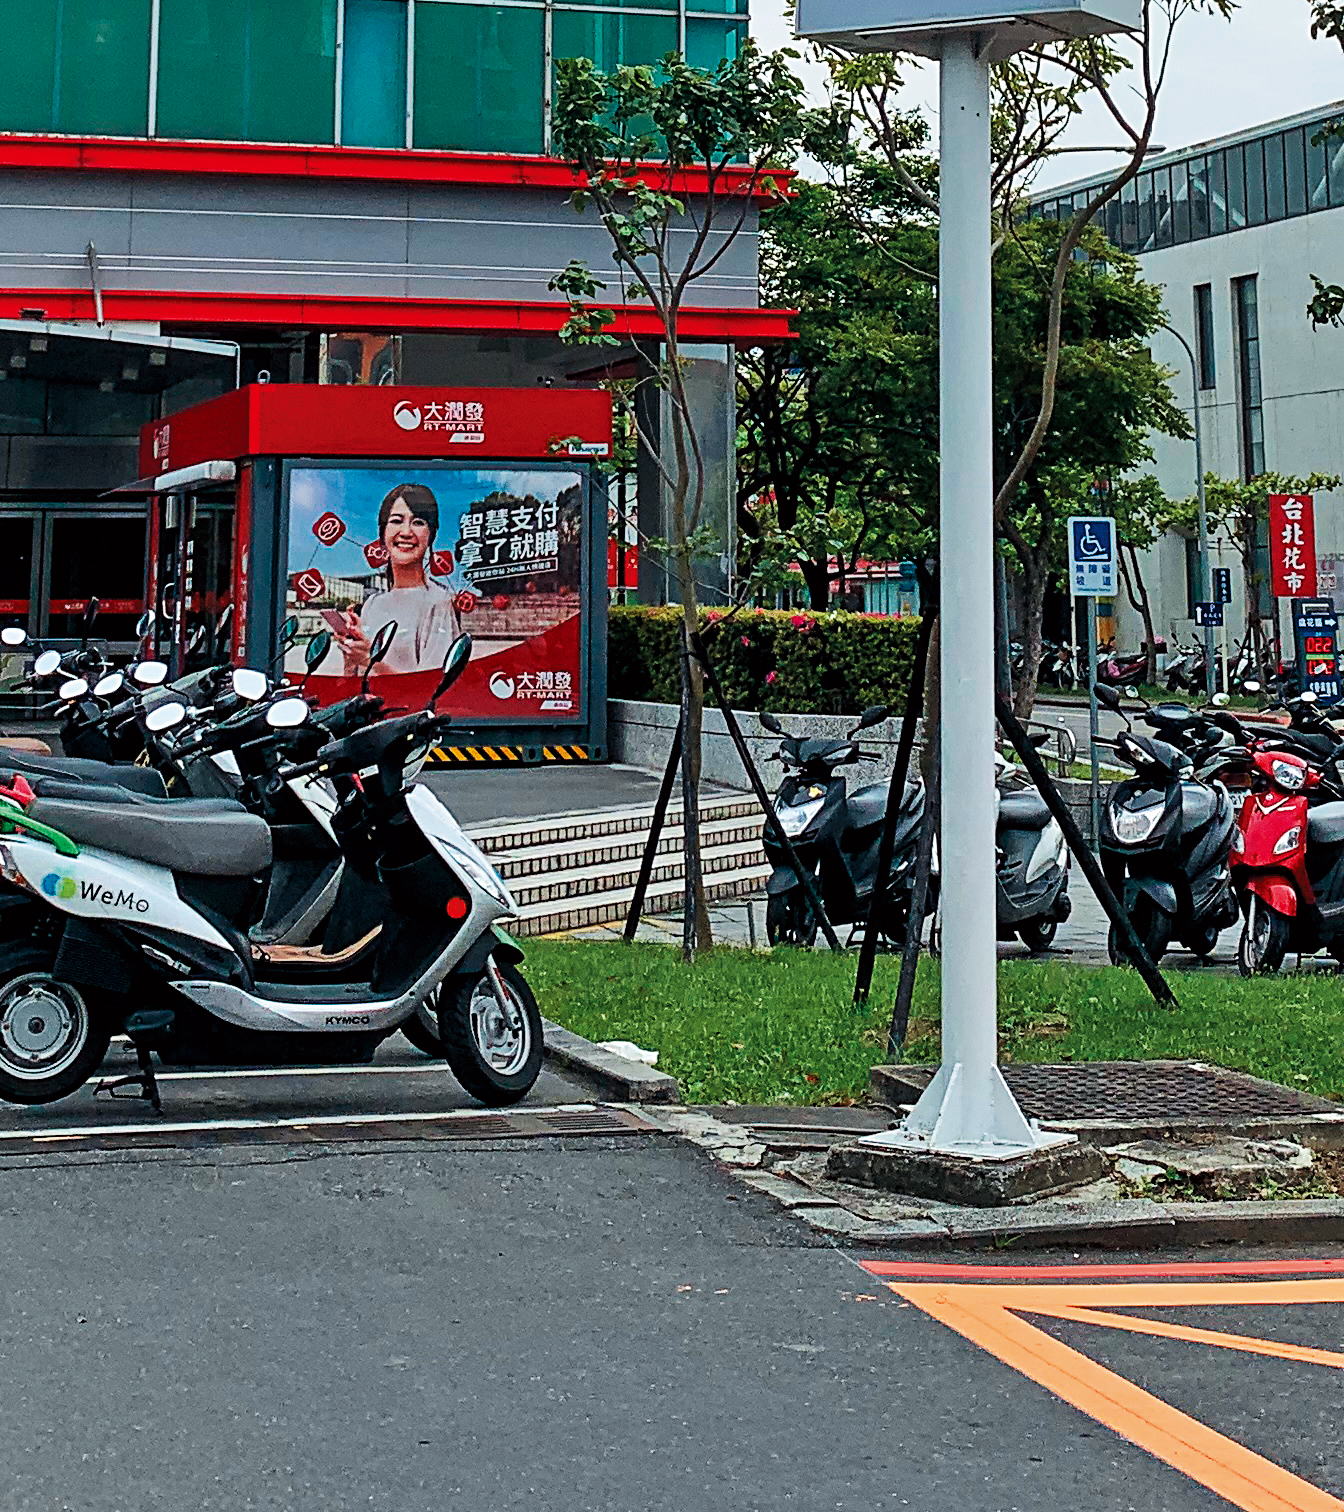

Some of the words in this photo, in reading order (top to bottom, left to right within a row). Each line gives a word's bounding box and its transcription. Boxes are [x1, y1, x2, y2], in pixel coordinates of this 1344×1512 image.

[423, 401, 484, 421] 大潤發
[423, 423, 484, 432] RT-MART
[459, 501, 560, 540] 智慧支付
[459, 529, 559, 568] 拿了就購
[1280, 497, 1307, 595] 台北花市
[516, 671, 572, 690] 大潤發
[80, 880, 150, 913] WeMo
[325, 1015, 371, 1026] KYMCO
